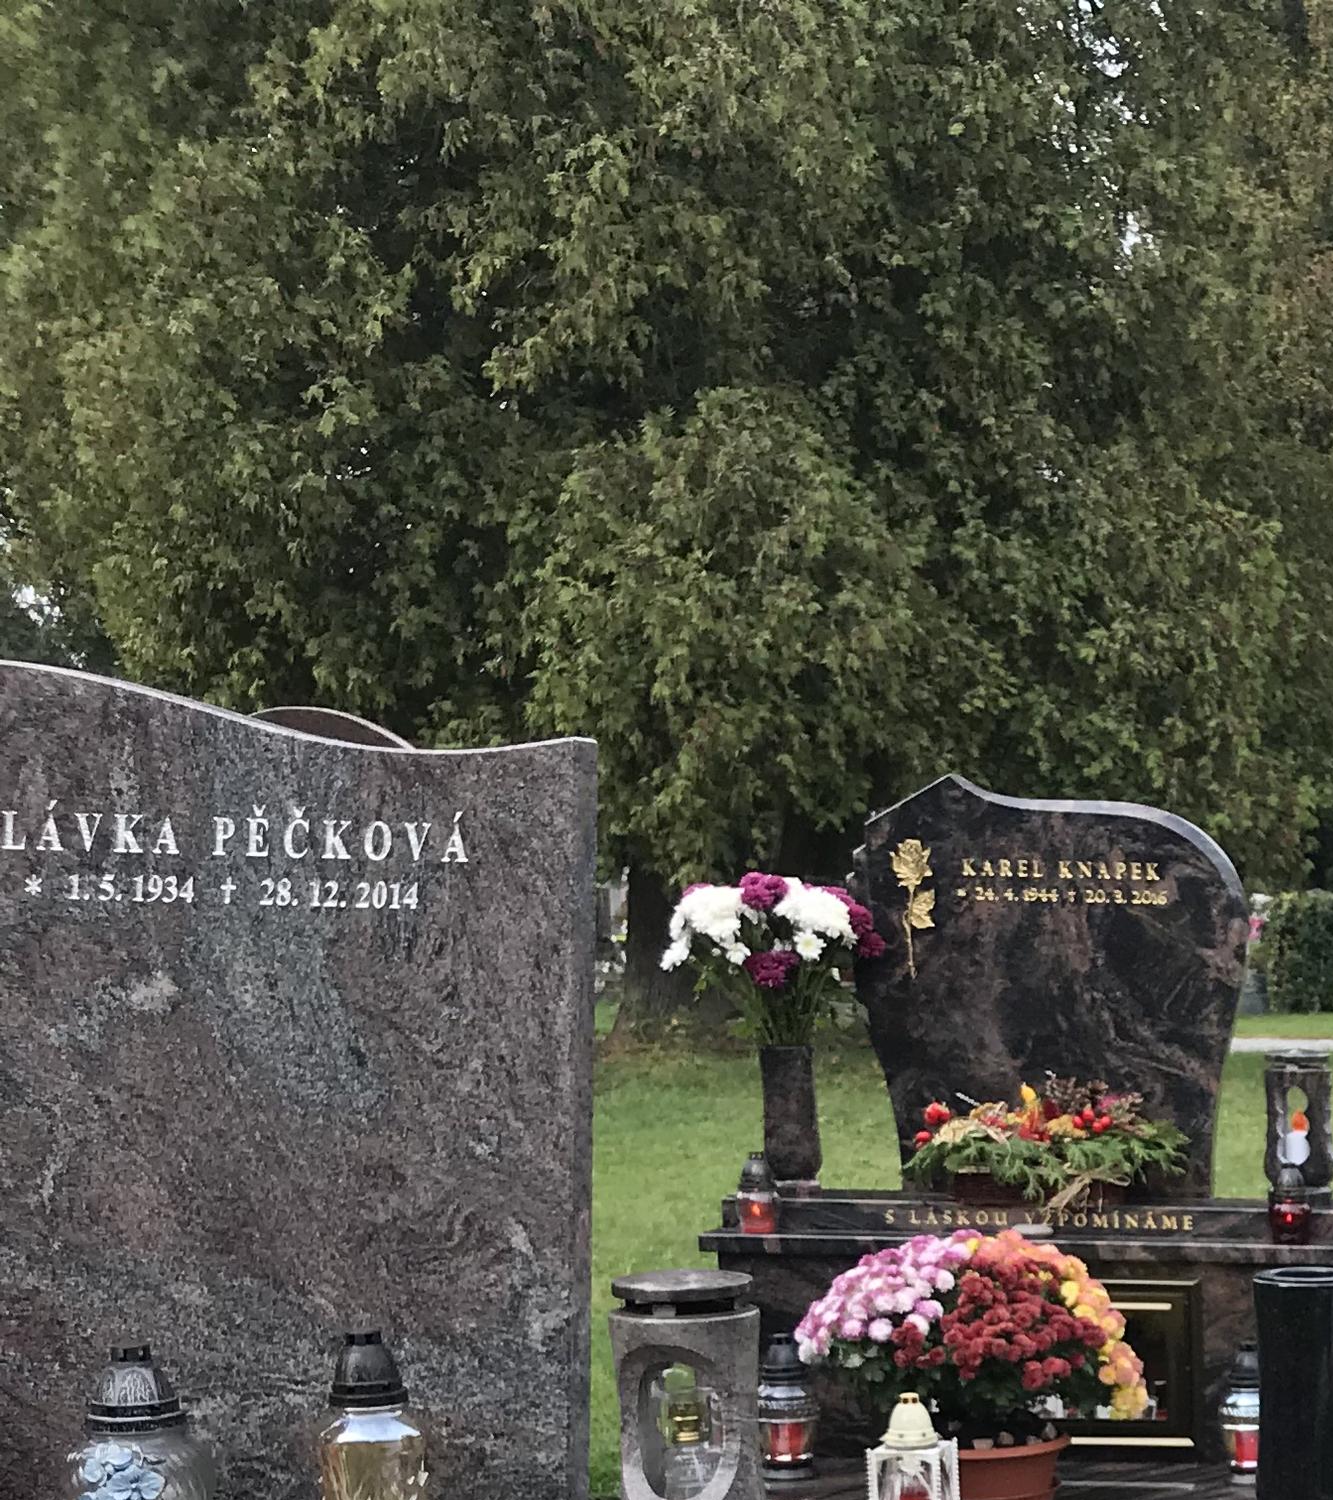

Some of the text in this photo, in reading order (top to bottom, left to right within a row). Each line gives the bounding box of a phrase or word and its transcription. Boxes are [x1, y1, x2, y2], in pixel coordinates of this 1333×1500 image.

[0, 799, 469, 862] LÁVKA PĚČKOVÁ
[961, 858, 1161, 881] KAREL KNAPEK
[67, 873, 420, 910] 1. 5. 1934 28. 12. 2014
[1085, 888, 1110, 904] 20.
[1113, 888, 1128, 905] 3.
[884, 1209, 895, 1225] S
[909, 1207, 1009, 1227] LÁSKOU
